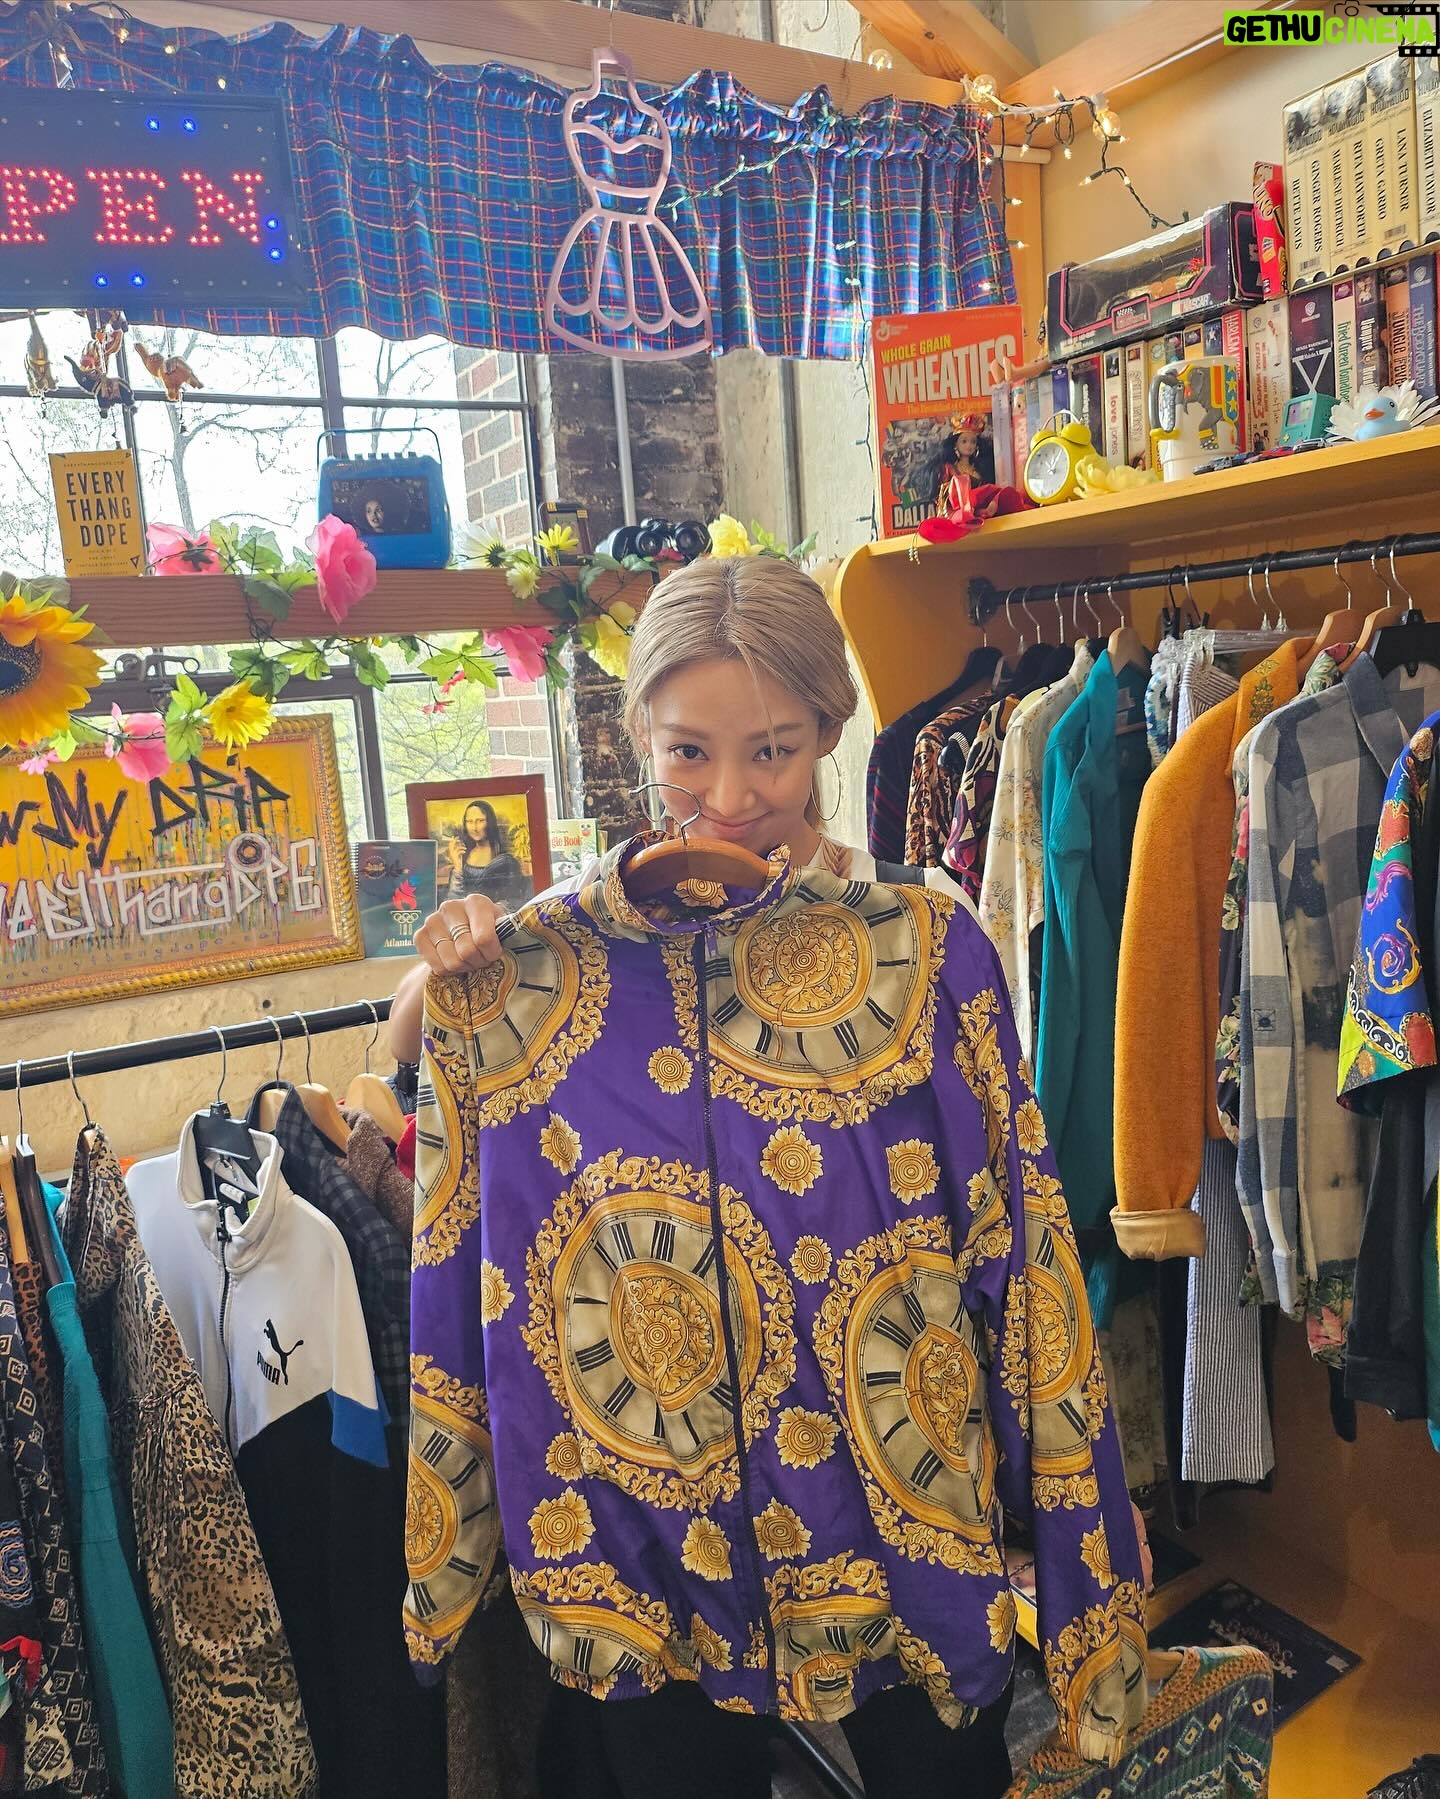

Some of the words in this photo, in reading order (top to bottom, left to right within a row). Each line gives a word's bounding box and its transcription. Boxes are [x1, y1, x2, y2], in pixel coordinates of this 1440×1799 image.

[1353, 141, 1363, 167] RITA
[1397, 128, 1407, 160] LANA
[1422, 108, 1433, 169] ELIZABETH
[1332, 149, 1342, 195] MARLENE
[1375, 138, 1385, 177] GRETA
[1292, 178, 1301, 215] BETTE
[1310, 160, 1321, 204] GINGER
[1377, 180, 1387, 220] GARBO
[1399, 161, 1409, 212] TURNER
[1425, 169, 1436, 214] TAYLOR
[0, 167, 264, 243] PEN
[1253, 183, 1274, 221] UNO
[1355, 171, 1366, 238] HAYWORTH
[1294, 218, 1303, 250] DAVIS
[1313, 206, 1323, 252] ROGERS
[1334, 197, 1344, 247] DIETRICH
[881, 343, 917, 364] WHOLE
[920, 334, 953, 355] GRAIN
[1224, 313, 1240, 353] HARLEM
[1337, 321, 1351, 342] Fried
[1358, 317, 1375, 351] Vampire
[883, 334, 1016, 405] WHEATIES
[1337, 342, 1351, 367] Green
[1411, 326, 1426, 389] BODYGUARD
[1110, 395, 1118, 423] love
[66, 470, 124, 495] EVERY
[66, 496, 131, 521] THANG
[893, 503, 937, 528] DALLA
[80, 522, 128, 547] DOPE
[551, 836, 562, 848] gle
[564, 835, 582, 847] Book
[384, 938, 412, 948] Atlanta
[257, 1350, 281, 1386] PUMA
